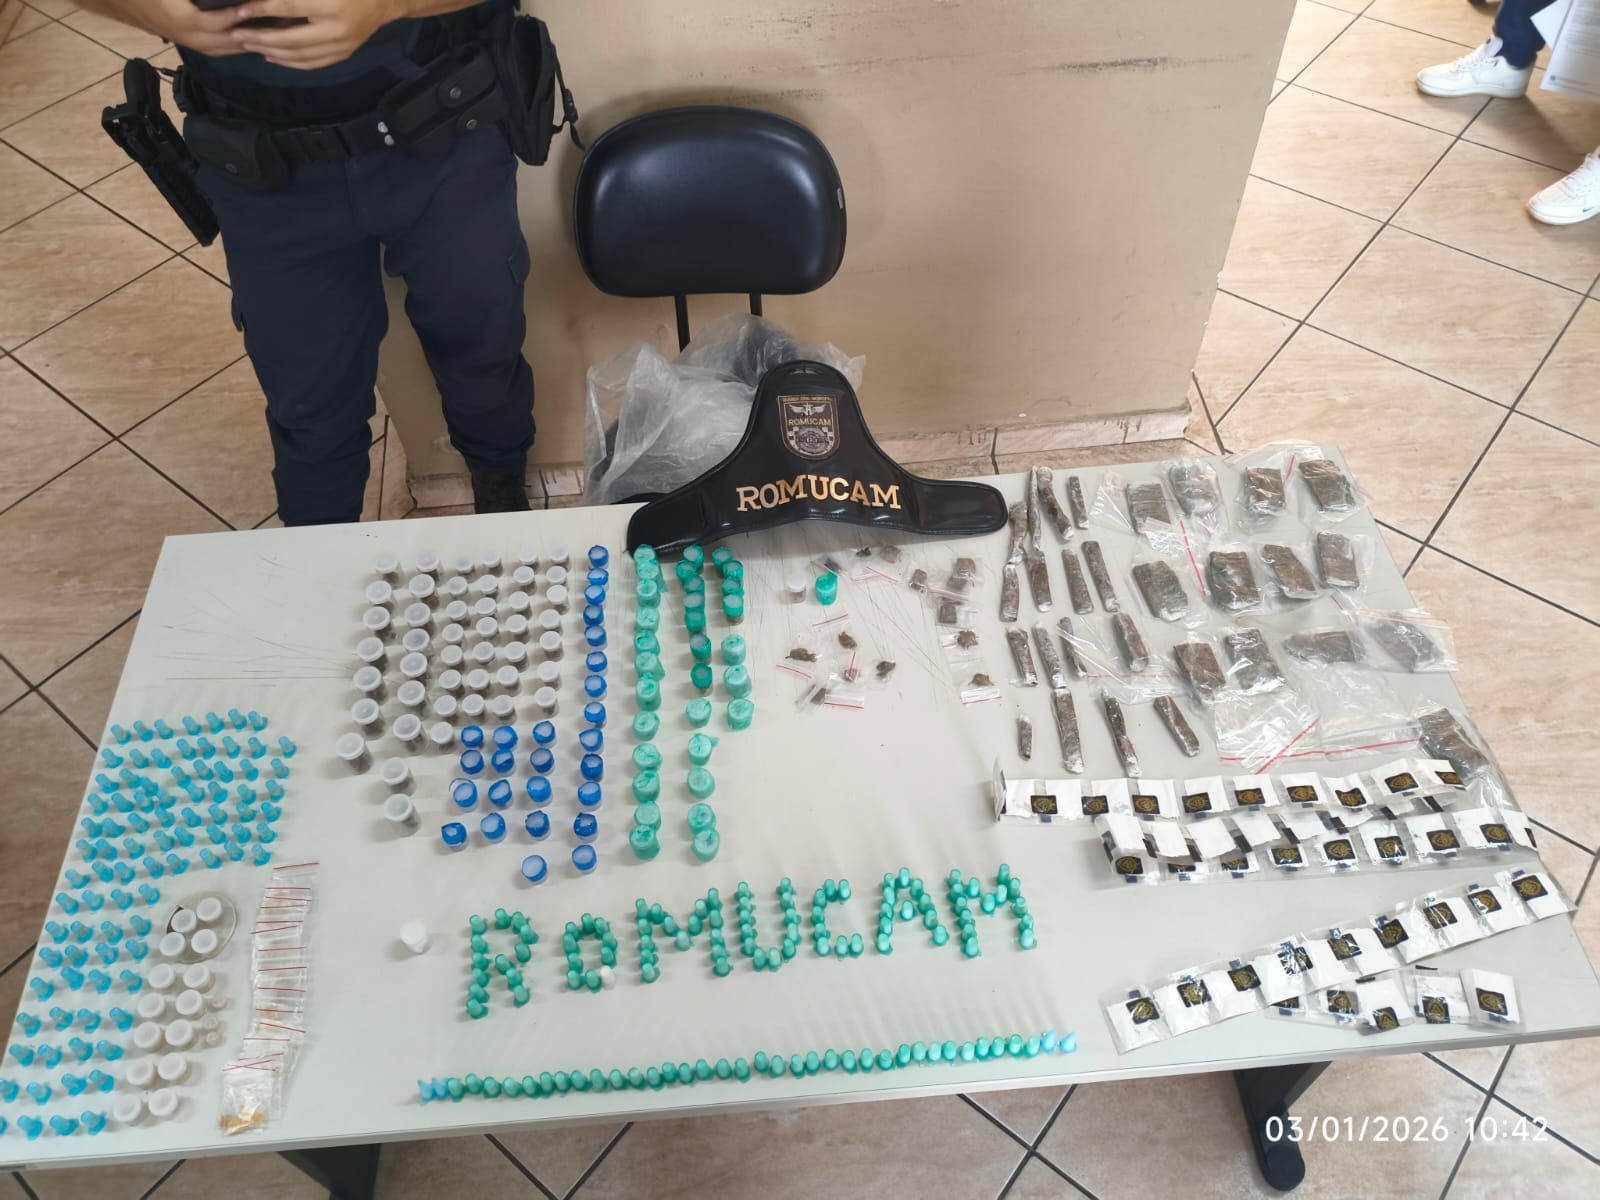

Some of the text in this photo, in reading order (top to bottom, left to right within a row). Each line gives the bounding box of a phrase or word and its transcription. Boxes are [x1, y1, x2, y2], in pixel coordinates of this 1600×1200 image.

[788, 418, 832, 427] ROMUCAM
[736, 474, 902, 512] ROMUCAM
[465, 863, 1037, 1020] ROMUCAM
